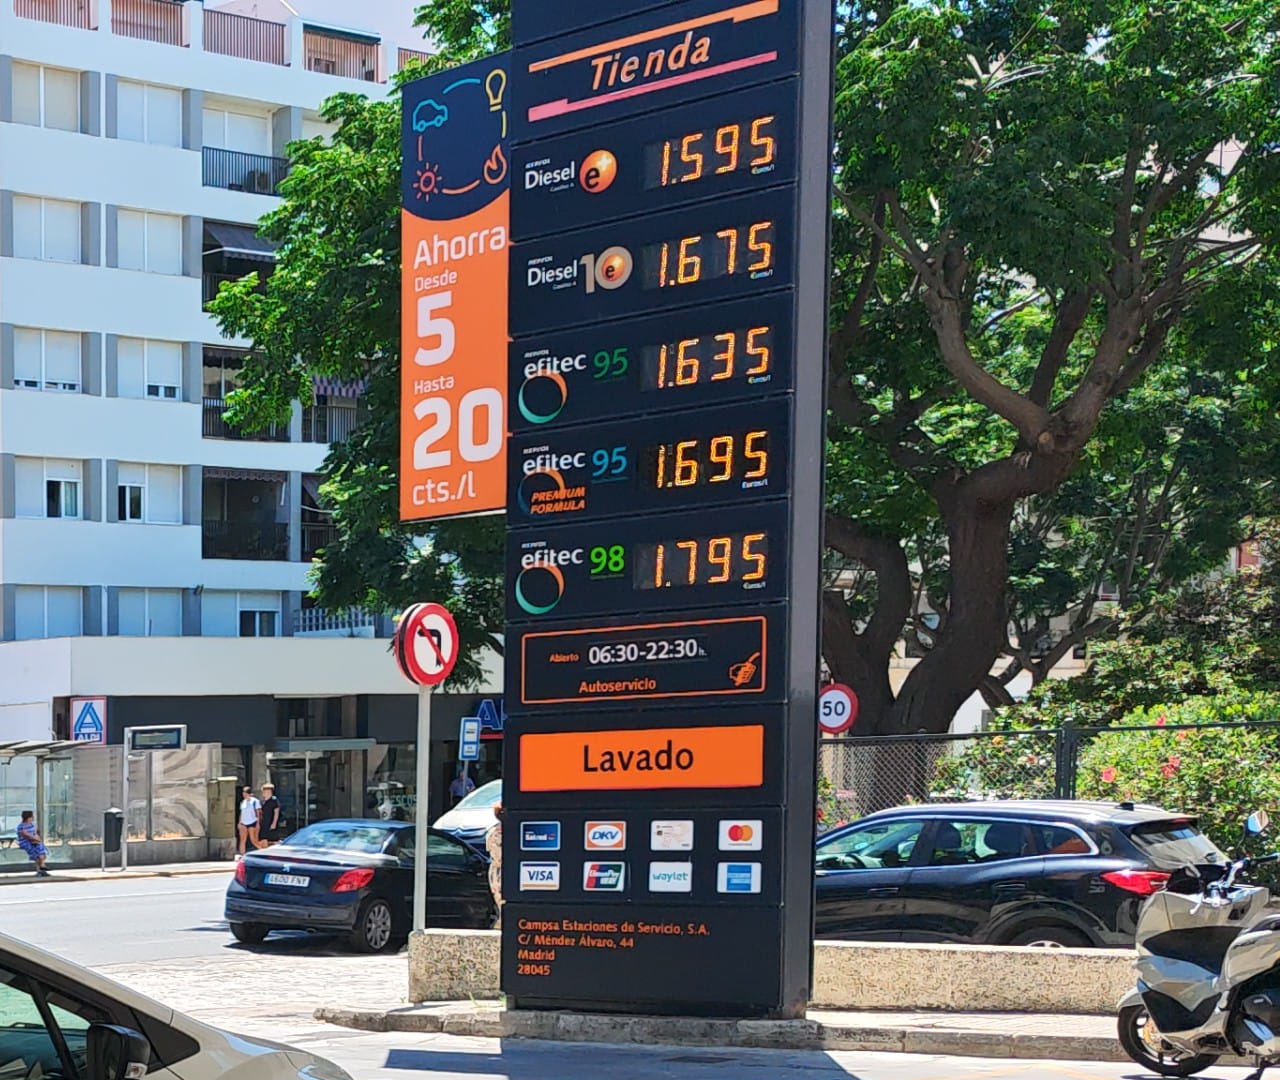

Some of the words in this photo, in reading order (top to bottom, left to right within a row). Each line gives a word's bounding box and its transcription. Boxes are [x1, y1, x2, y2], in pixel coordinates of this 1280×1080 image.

[591, 31, 710, 90] Tienda
[525, 161, 575, 190] Diesel
[661, 116, 775, 186] 1.595
[413, 225, 505, 270] Ahorra
[527, 259, 577, 287] Diesel
[659, 221, 772, 288] 1.675
[415, 270, 458, 292] Desde
[414, 290, 455, 366] 5
[524, 354, 587, 380] efitec
[593, 348, 629, 379] 95
[658, 327, 769, 389] 1.635
[414, 375, 455, 395] Hasta
[413, 387, 503, 471] 20
[523, 452, 586, 475] efitec
[592, 446, 627, 477] 95
[657, 431, 767, 488] 1.695
[412, 470, 476, 506] cts./l
[531, 486, 586, 503] PREMIUM
[530, 500, 585, 515] FORMULA
[521, 548, 583, 569] efitec
[591, 545, 625, 574] 98
[655, 533, 766, 588] 1.795
[550, 653, 579, 663] Abierto
[589, 638, 698, 665] 06:30-22:30
[579, 678, 656, 694] Autoservicio
[823, 701, 845, 716] 50
[583, 739, 694, 772] Lavado
[592, 831, 619, 840] DKV
[528, 870, 553, 880] VISA
[652, 872, 688, 883] waylet
[518, 919, 559, 932] Campsa
[562, 920, 617, 932] Estaciones
[620, 922, 634, 933] de
[637, 923, 684, 936] Servicio,
[687, 924, 710, 935] S.A.
[517, 934, 532, 945] C/
[534, 934, 575, 946] Méndez
[619, 937, 634, 948] 44
[517, 949, 555, 961] Madrid
[517, 964, 551, 976] 28045
